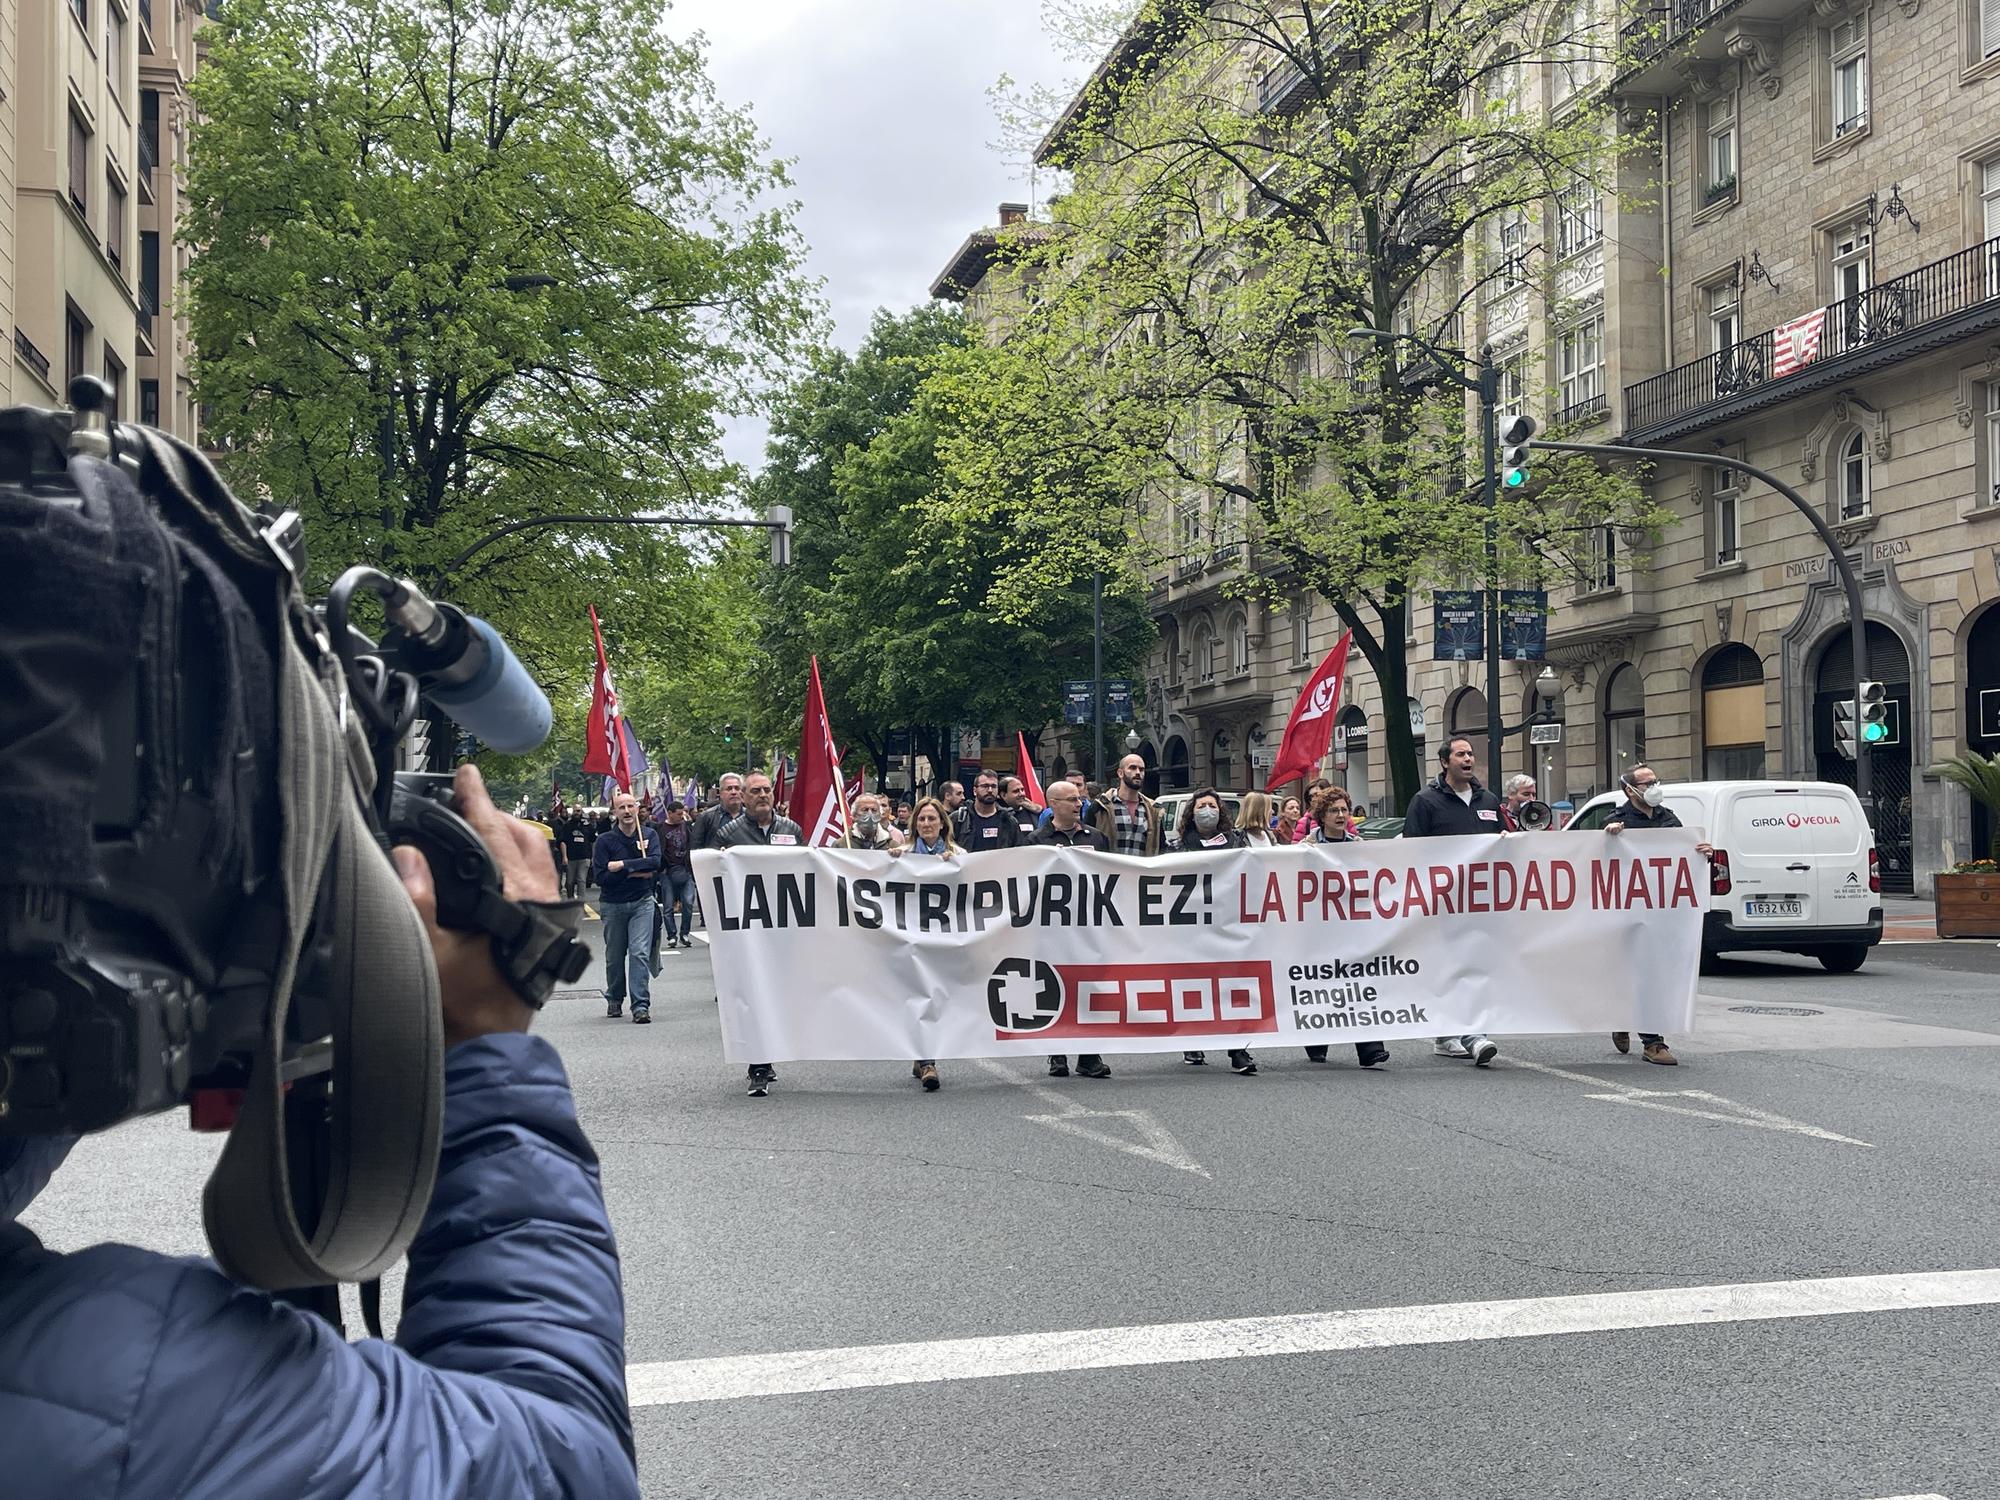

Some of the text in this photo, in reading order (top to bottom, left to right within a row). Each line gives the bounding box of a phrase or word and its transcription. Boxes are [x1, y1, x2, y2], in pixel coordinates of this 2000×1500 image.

[1751, 816, 1841, 828] GIROA VEOLIA
[713, 873, 1213, 932] LAN ISTRIPURIK EZ!
[1239, 857, 1699, 923] LA PRECARIEDAD MATA
[1753, 902, 1799, 914] 1632 KXG
[1288, 955, 1420, 981] euskadiko
[1077, 977, 1262, 1024] CCOO
[1290, 983, 1378, 1009] langile
[1293, 1004, 1429, 1030] komisioak
